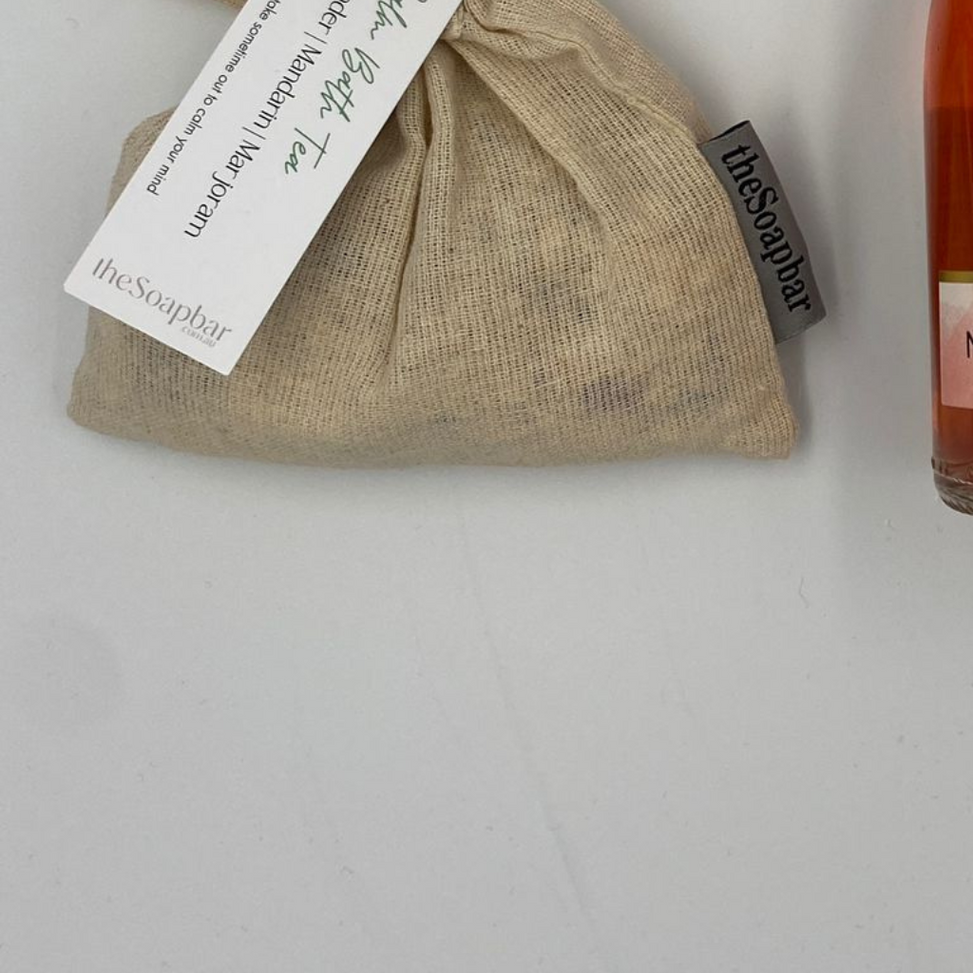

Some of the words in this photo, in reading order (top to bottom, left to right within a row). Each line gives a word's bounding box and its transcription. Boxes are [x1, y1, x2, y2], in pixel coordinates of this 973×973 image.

[225, 21, 262, 72] sometime
[203, 93, 218, 106] to
[212, 74, 228, 94] out
[253, 43, 322, 129] Mandarin
[319, 47, 380, 123] Bath
[183, 108, 203, 135] calm
[167, 135, 188, 163] your
[284, 127, 331, 175] Tea
[146, 164, 170, 196] mind
[721, 144, 811, 312] theSoapbar
